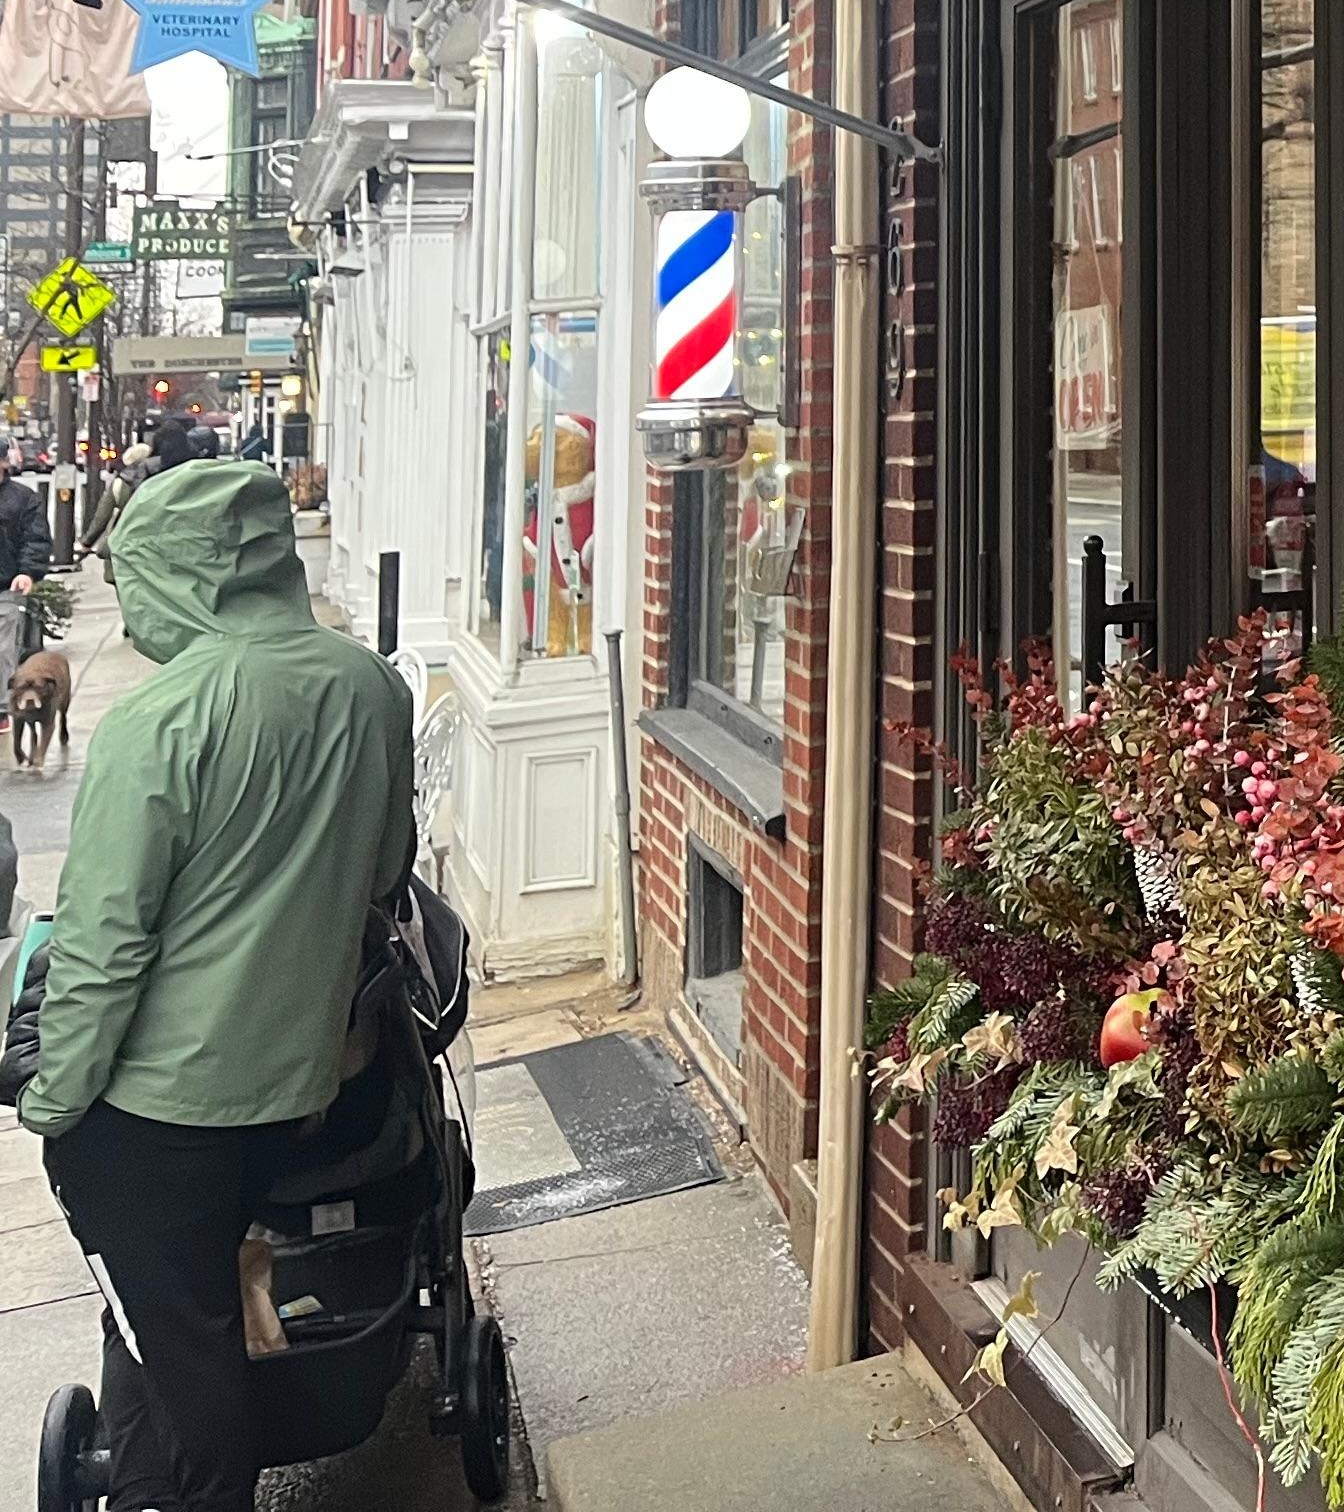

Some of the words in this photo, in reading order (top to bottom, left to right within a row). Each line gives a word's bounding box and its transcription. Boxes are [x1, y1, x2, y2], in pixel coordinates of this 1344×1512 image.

[151, 13, 241, 26] VETERINARY
[160, 26, 232, 38] HOSPITAL
[140, 210, 230, 235] MAXX'S
[136, 237, 230, 254] PRODUCE
